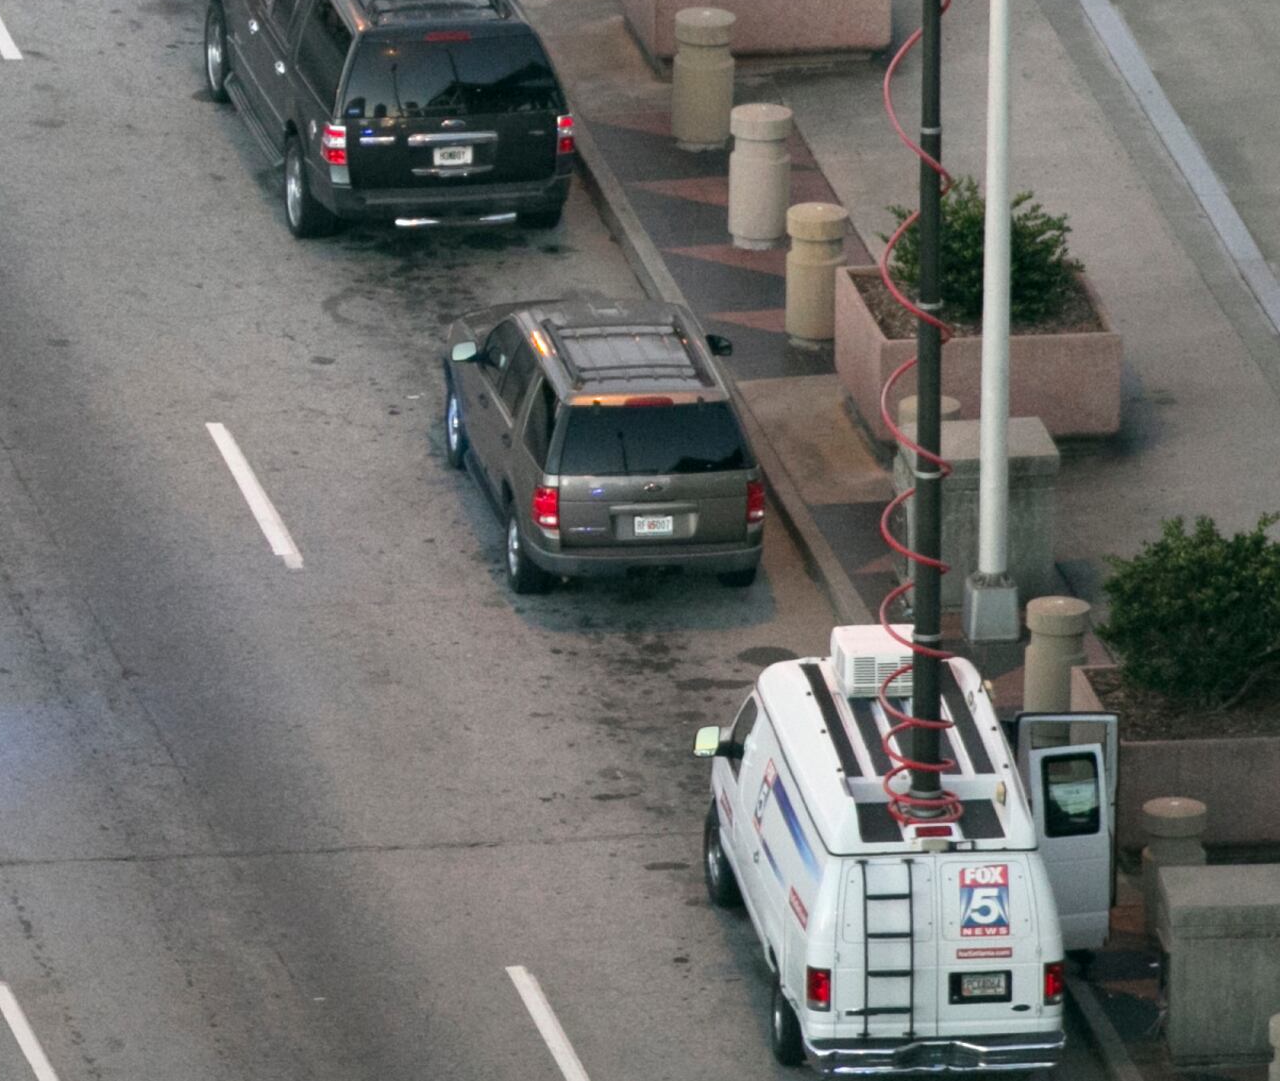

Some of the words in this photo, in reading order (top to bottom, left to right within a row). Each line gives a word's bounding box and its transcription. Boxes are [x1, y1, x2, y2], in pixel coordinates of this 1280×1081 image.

[964, 865, 1005, 886] FOX
[969, 887, 1000, 925] 5
[962, 926, 1009, 937] NEWS
